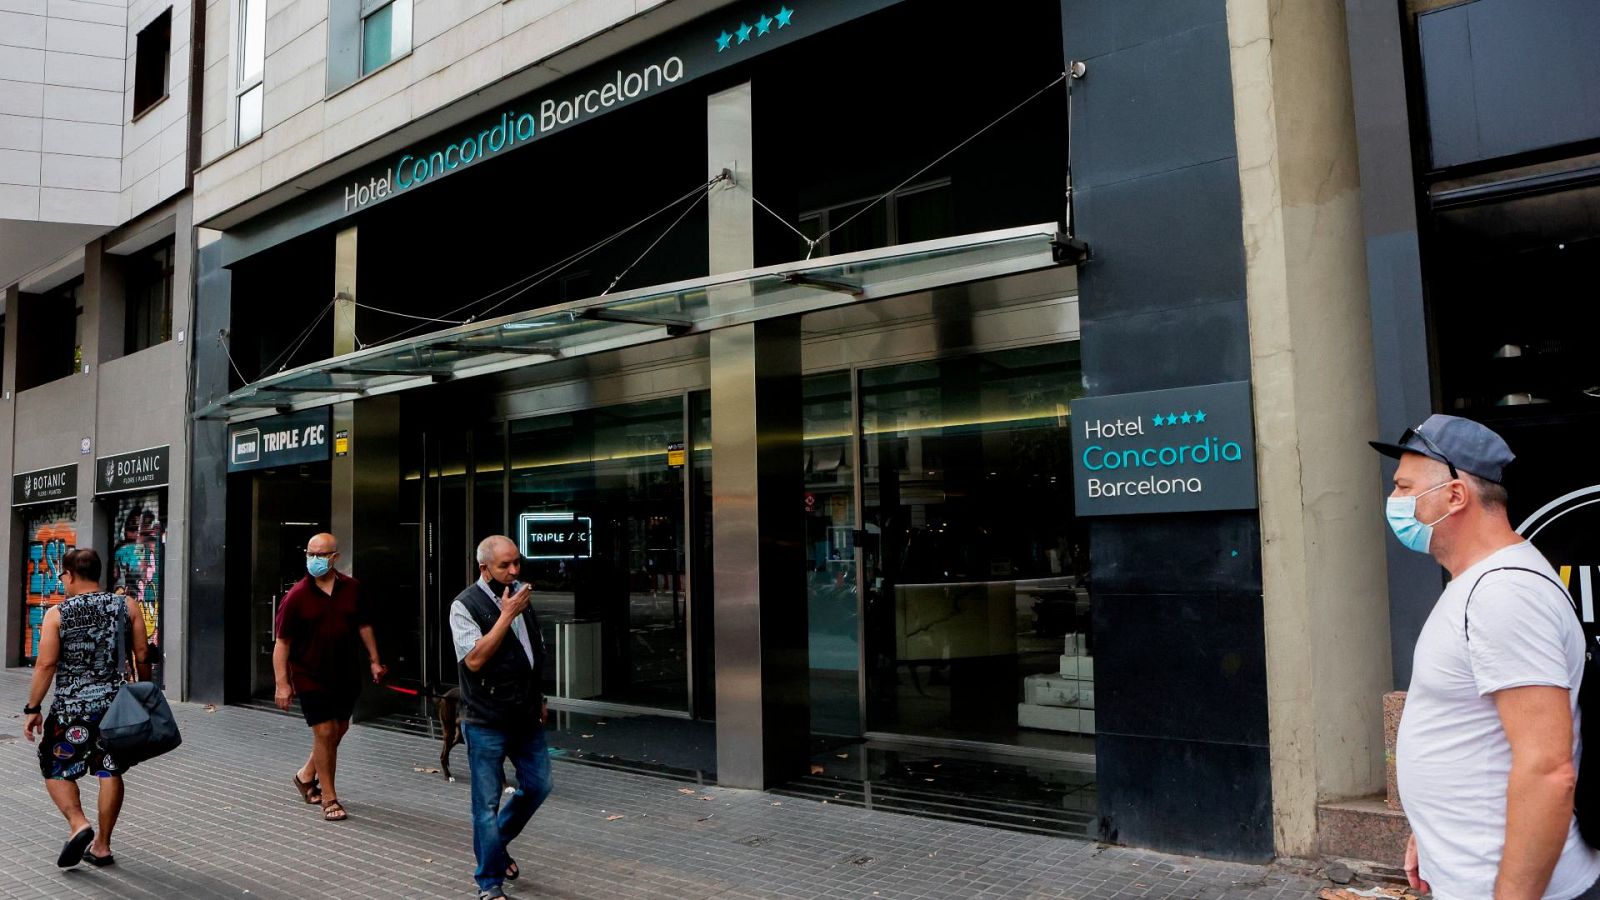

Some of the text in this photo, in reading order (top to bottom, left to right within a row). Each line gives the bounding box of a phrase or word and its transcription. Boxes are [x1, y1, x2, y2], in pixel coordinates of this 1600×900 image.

[344, 55, 684, 212] Hotel Concordia Barcelona
[263, 429, 299, 452] TRIPLE
[302, 424, 325, 447] SEC
[1085, 416, 1145, 439] Hotel
[1083, 437, 1242, 470] Concordia
[1087, 475, 1203, 498] Barcelona
[530, 532, 565, 542] TRIPLE
